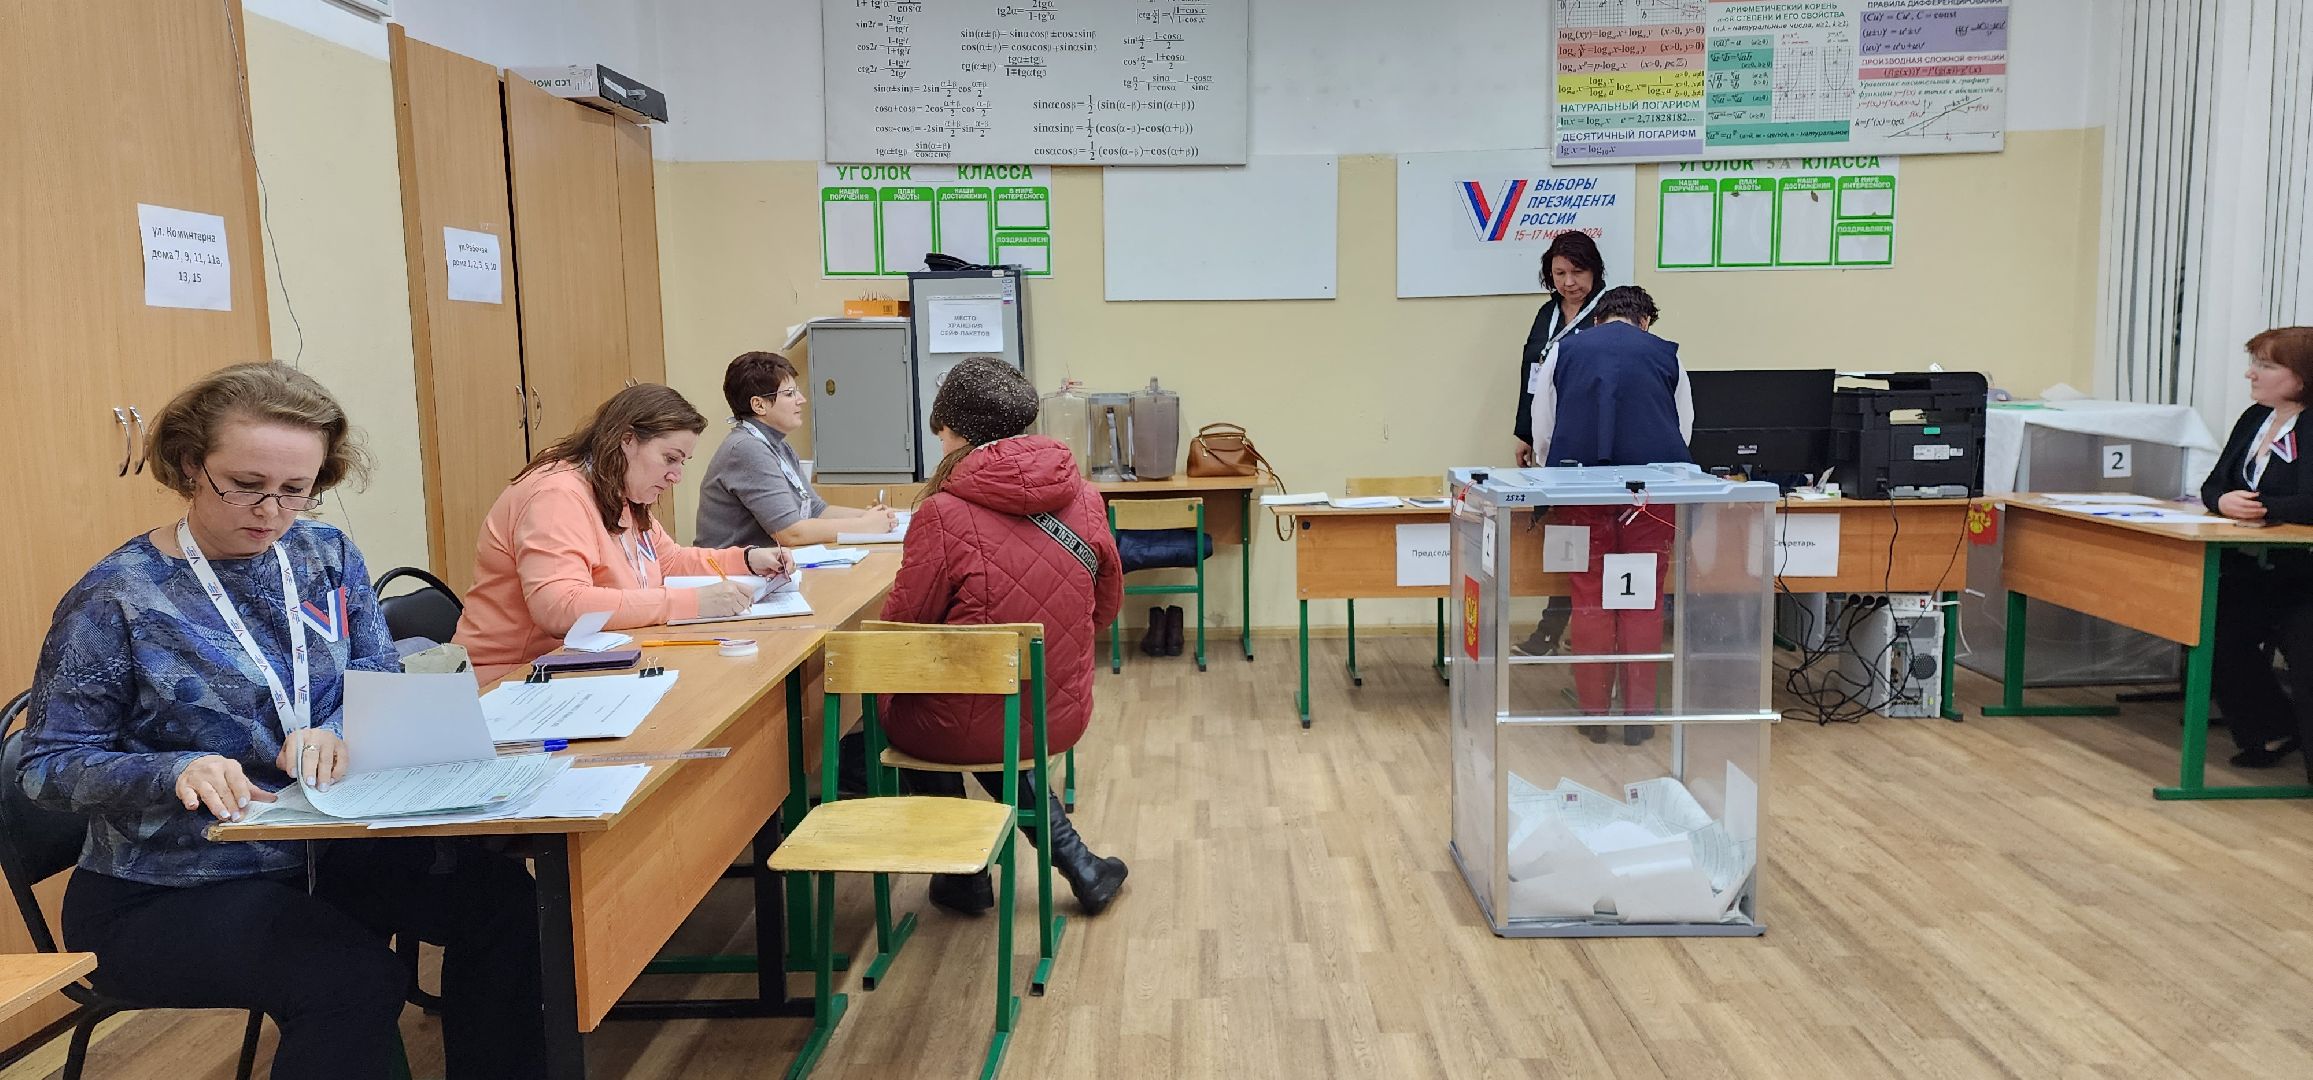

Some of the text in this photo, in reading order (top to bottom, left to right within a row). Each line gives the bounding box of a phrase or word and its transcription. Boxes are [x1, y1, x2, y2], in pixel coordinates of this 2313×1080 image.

[1726, 3, 1838, 13] АРИФМЕТИЧЕСКИЙ КОРЕНЬ
[1801, 11, 1845, 19] СВОЙСТВА
[1925, 55, 1965, 63] СЛОЖНОЙ
[1561, 100, 1700, 113] НАТУРАЛЬНЫЙ ЛОГАРИФМ
[1562, 130, 1635, 143] ДЕСЯТИЧНЫЙ
[1639, 129, 1697, 140] ЛОГАРИФМ
[1679, 160, 1754, 172] УГОЛОК
[1802, 156, 1881, 170] КЛАССА
[837, 165, 1033, 181] УГОЛОК КЛАССА
[1534, 178, 1598, 192] ВЫБОРЫ
[1527, 194, 1617, 210] ПРЕЗИДЕНТА
[1519, 212, 1578, 227] РОССИИ
[152, 227, 165, 238] ул.
[152, 250, 174, 261] дома
[179, 272, 202, 284] 13, 15
[2112, 452, 2125, 470] 2
[1621, 573, 1636, 596] 1
